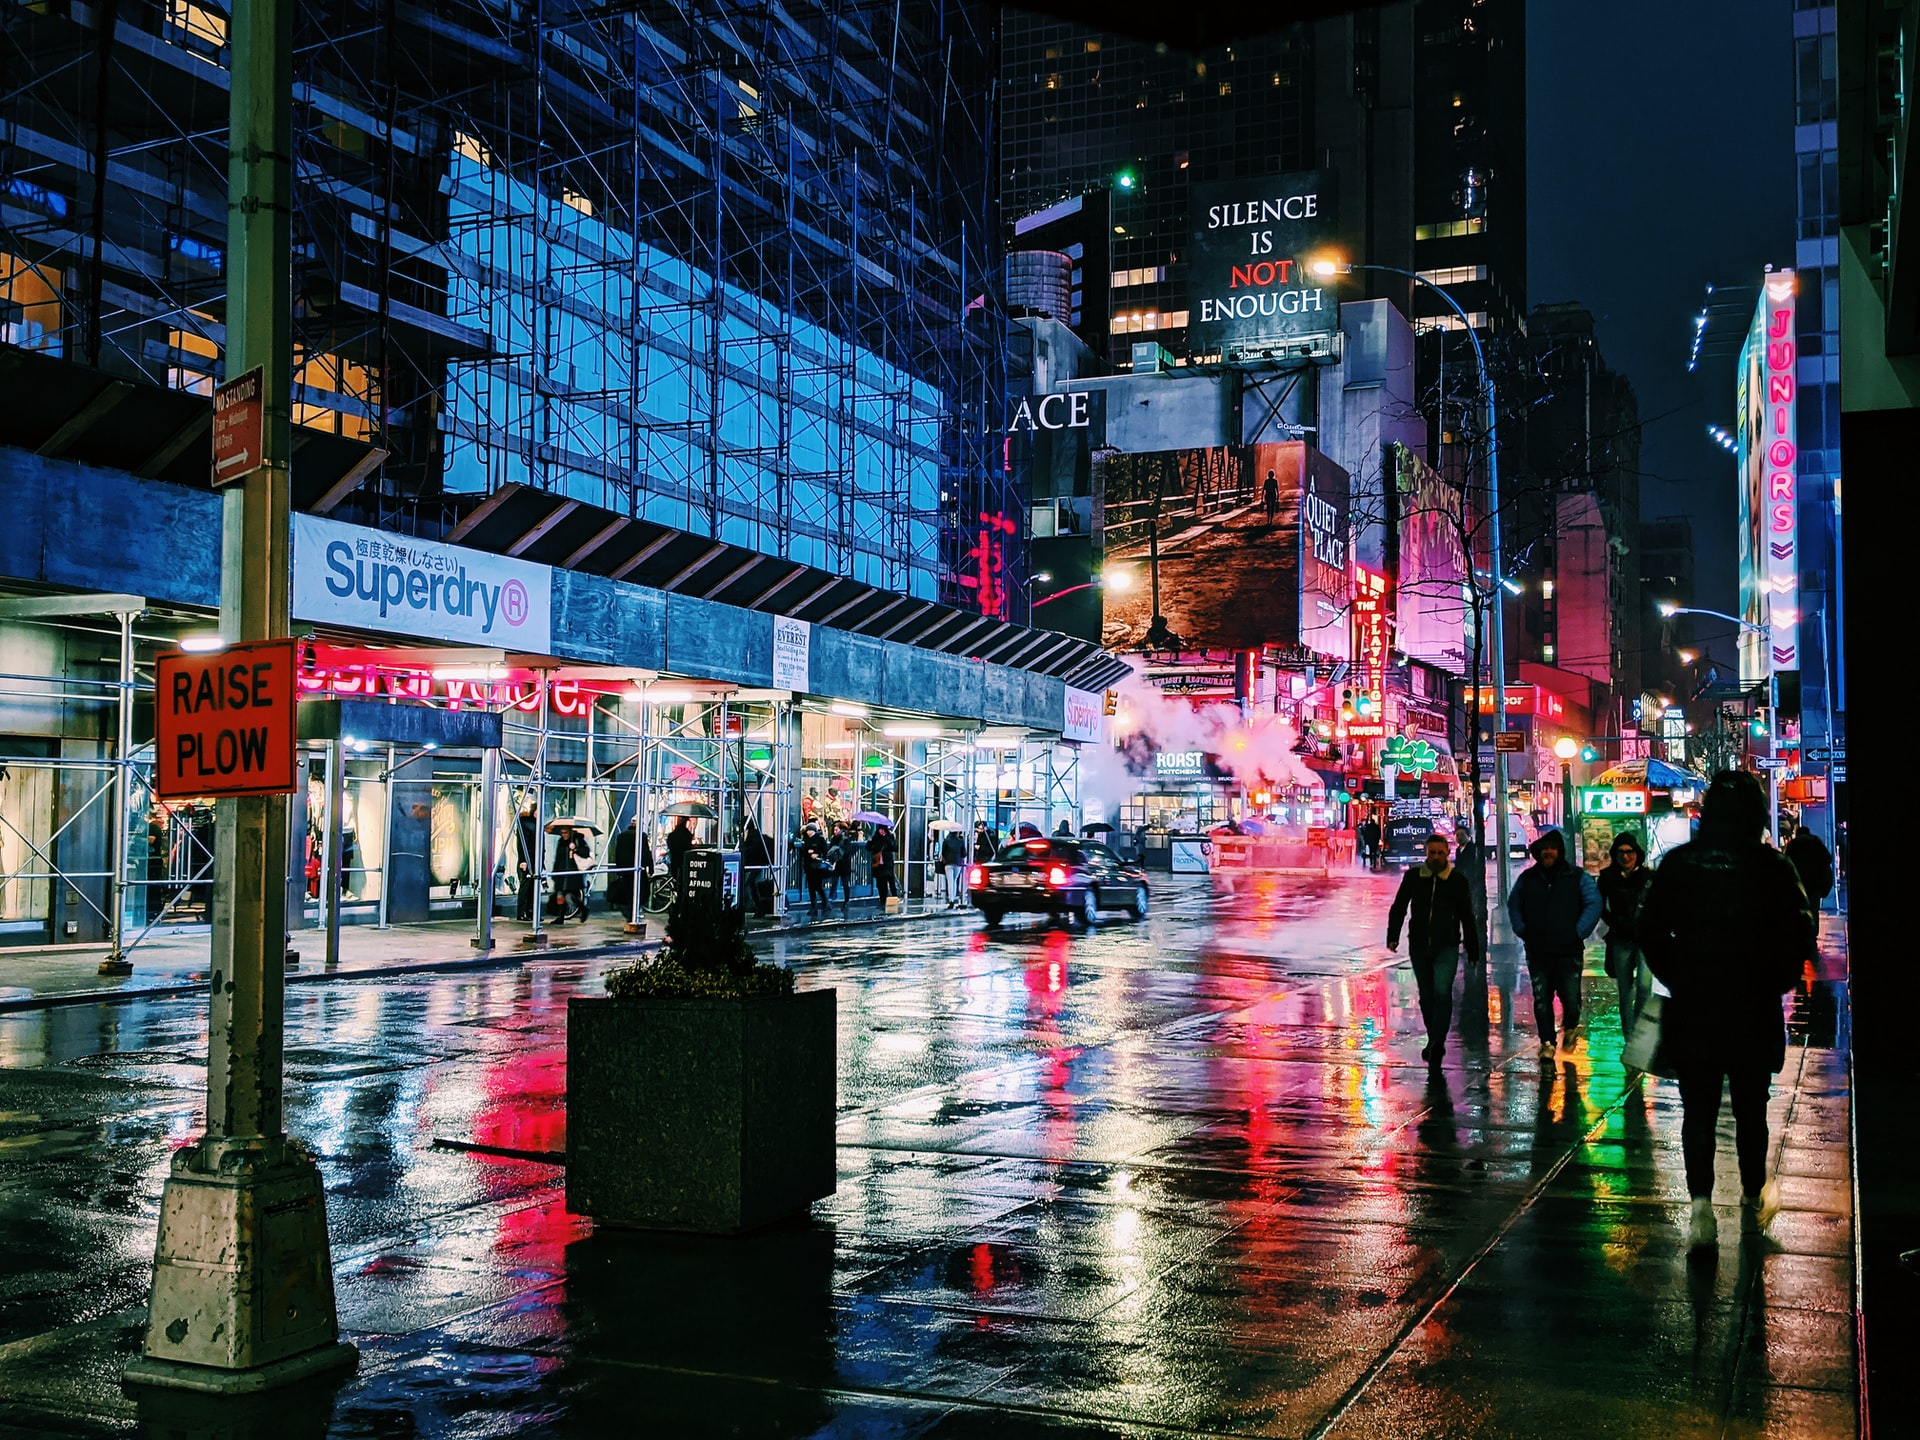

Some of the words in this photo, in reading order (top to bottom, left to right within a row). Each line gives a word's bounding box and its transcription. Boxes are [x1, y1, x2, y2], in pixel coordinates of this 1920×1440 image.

[1208, 194, 1318, 229] SILENCE
[1251, 231, 1273, 255] IS
[1230, 259, 1293, 289] NOT
[1200, 288, 1323, 323] ENOUGH
[216, 392, 225, 413] NO
[225, 378, 256, 409] STANDING
[996, 391, 1090, 433] ACE
[1767, 308, 1797, 534] JUNIORS
[1309, 474, 1317, 493] A
[1305, 492, 1337, 536] QUIET
[355, 537, 459, 574] 極度乾燥(しなさい)
[1313, 527, 1345, 571] PLACE
[1316, 562, 1338, 597] PART
[1356, 601, 1377, 611] THE
[776, 628, 808, 647] EVEREST
[173, 662, 273, 715] RAISE
[1185, 675, 1235, 687] RESTAURANT
[1348, 725, 1384, 737] TAVERN
[177, 726, 268, 778] PLOW
[1156, 751, 1203, 769] ROAST
[1477, 755, 1495, 763] ARRIS
[689, 860, 707, 868] DON'T
[1174, 856, 1195, 864] FROZEN
[688, 880, 711, 888] AFRAID
[689, 870, 698, 878] BE
